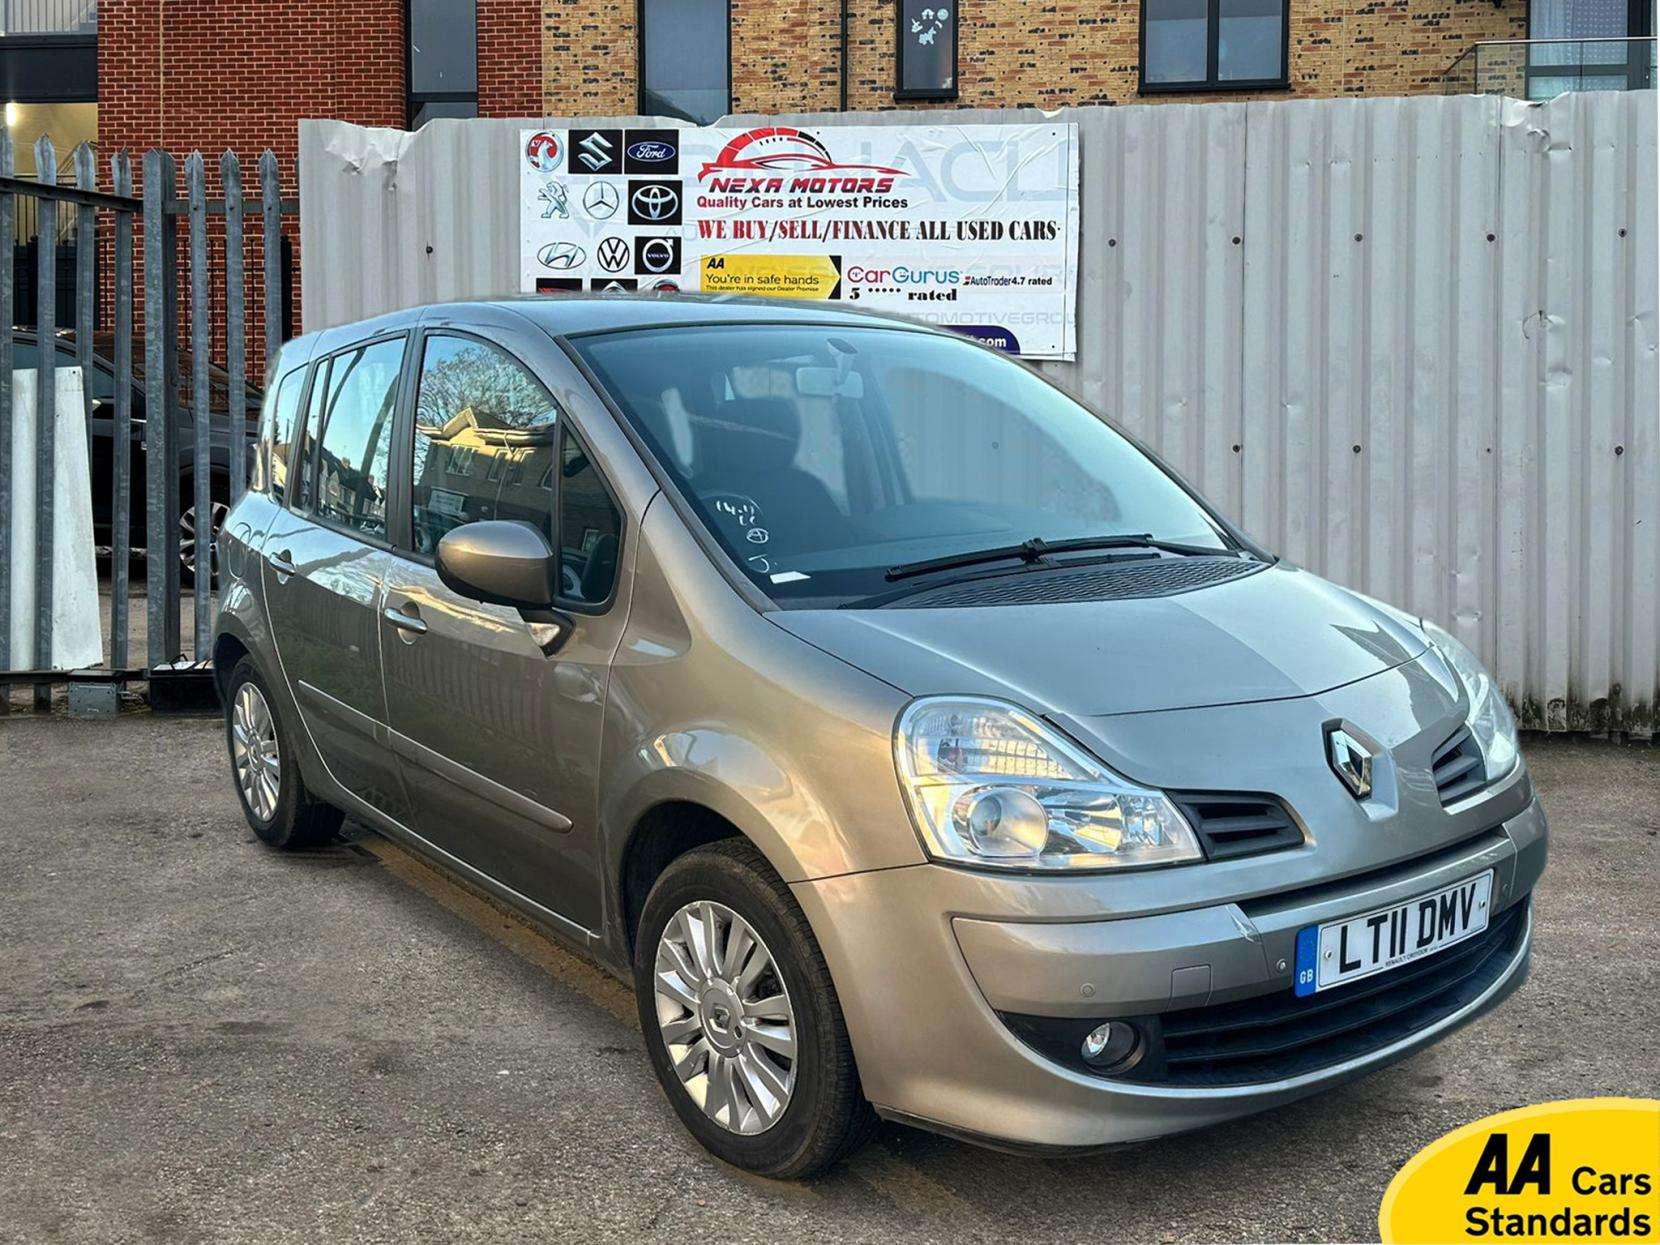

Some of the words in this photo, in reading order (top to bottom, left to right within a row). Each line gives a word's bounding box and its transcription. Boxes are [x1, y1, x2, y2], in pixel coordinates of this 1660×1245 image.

[636, 144, 666, 159] Ford
[708, 178, 784, 193] NEXA
[789, 178, 896, 193] MOTORS
[697, 196, 747, 210] Quality
[751, 196, 784, 208] Cars
[788, 196, 802, 208] at
[807, 196, 859, 208] Lowest
[863, 196, 908, 208] Prices
[698, 220, 726, 239] WE
[917, 220, 950, 240] ALL
[957, 220, 1004, 240] USED
[1008, 220, 1057, 240] CARS
[707, 258, 724, 269] AA
[706, 273, 741, 284] You're
[744, 273, 754, 284] in
[757, 274, 781, 285] safe
[784, 275, 819, 285] hands
[847, 266, 959, 284] CarGurus
[1028, 276, 1053, 286] rated
[849, 288, 861, 300] 5
[908, 288, 957, 301] rated
[1416, 883, 1477, 948] DMV
[1299, 968, 1314, 985] GB
